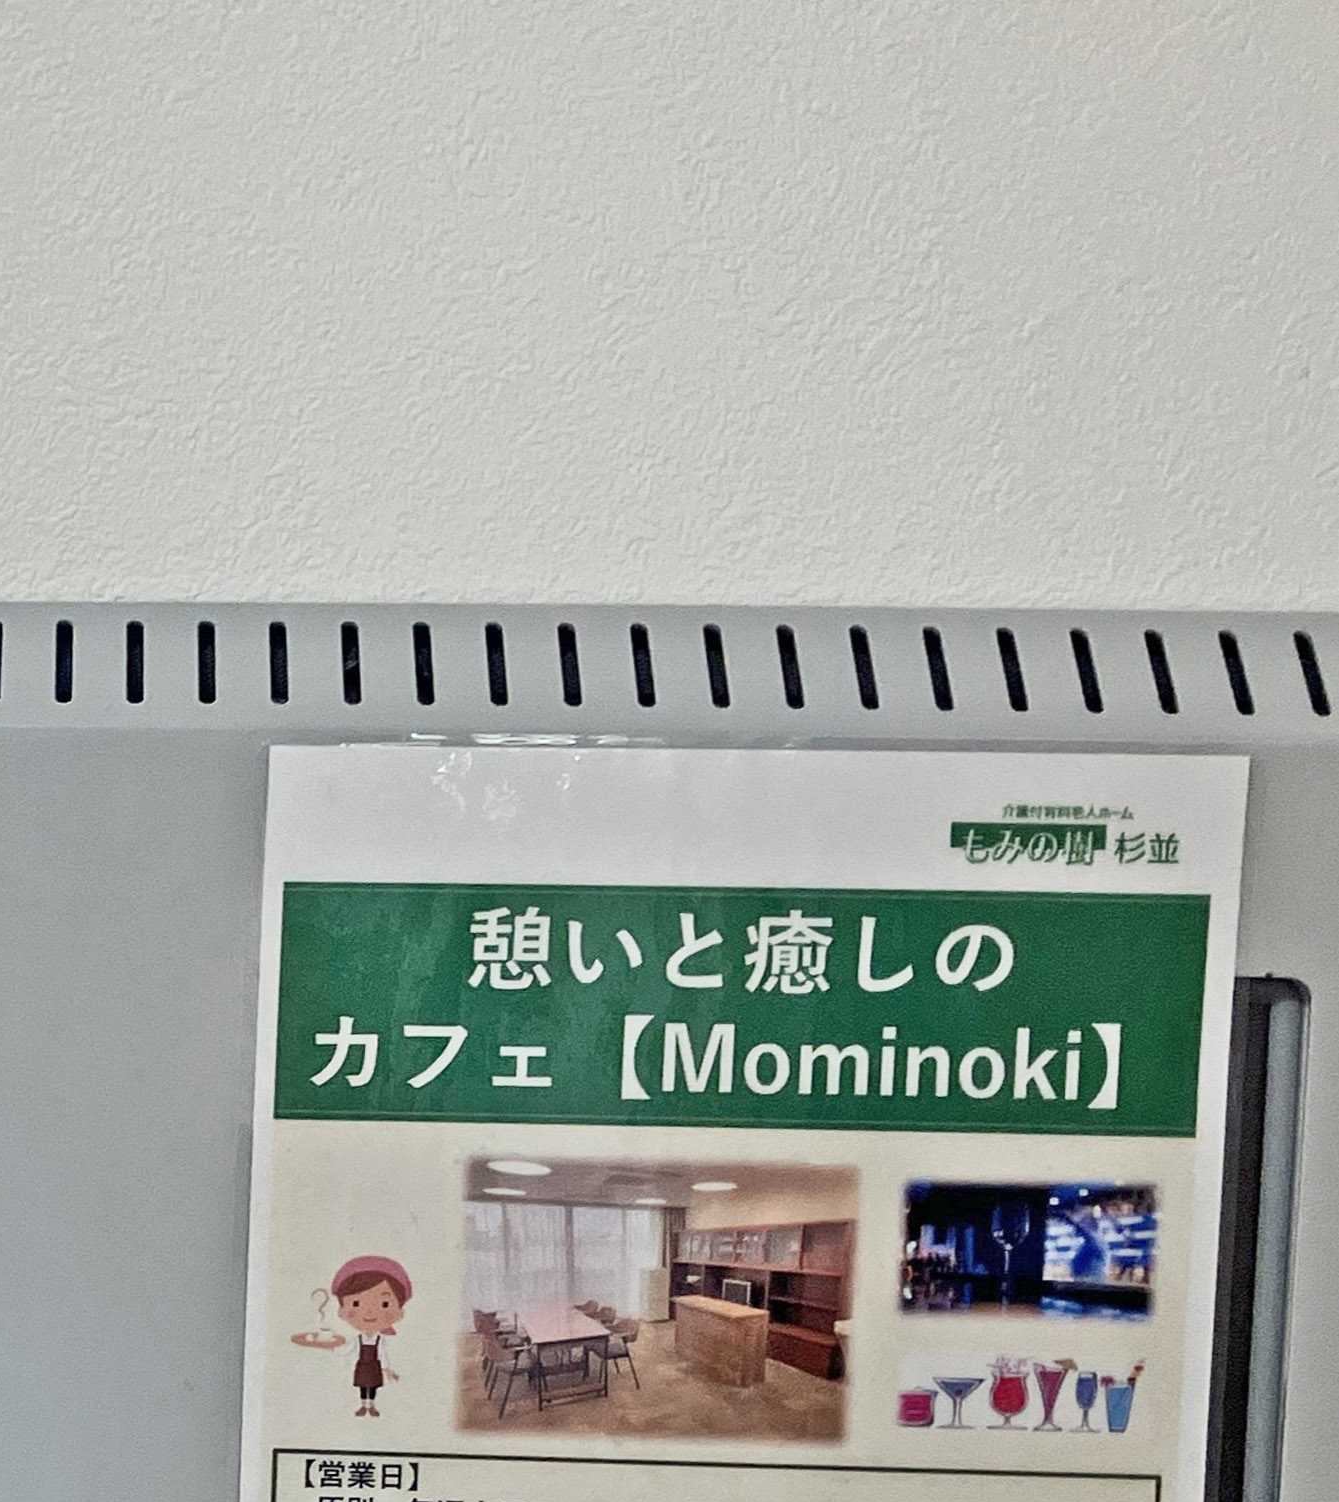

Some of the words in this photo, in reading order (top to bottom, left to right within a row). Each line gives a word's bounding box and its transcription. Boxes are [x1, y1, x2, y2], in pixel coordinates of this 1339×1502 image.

[963, 828, 1093, 865] もみの樹
[1114, 832, 1179, 864] 杉並
[468, 908, 1015, 994] 憩いと癒しの
[309, 1014, 1119, 1111] カフェ【Mominoki】
[305, 1459, 419, 1491] 【営業日】
